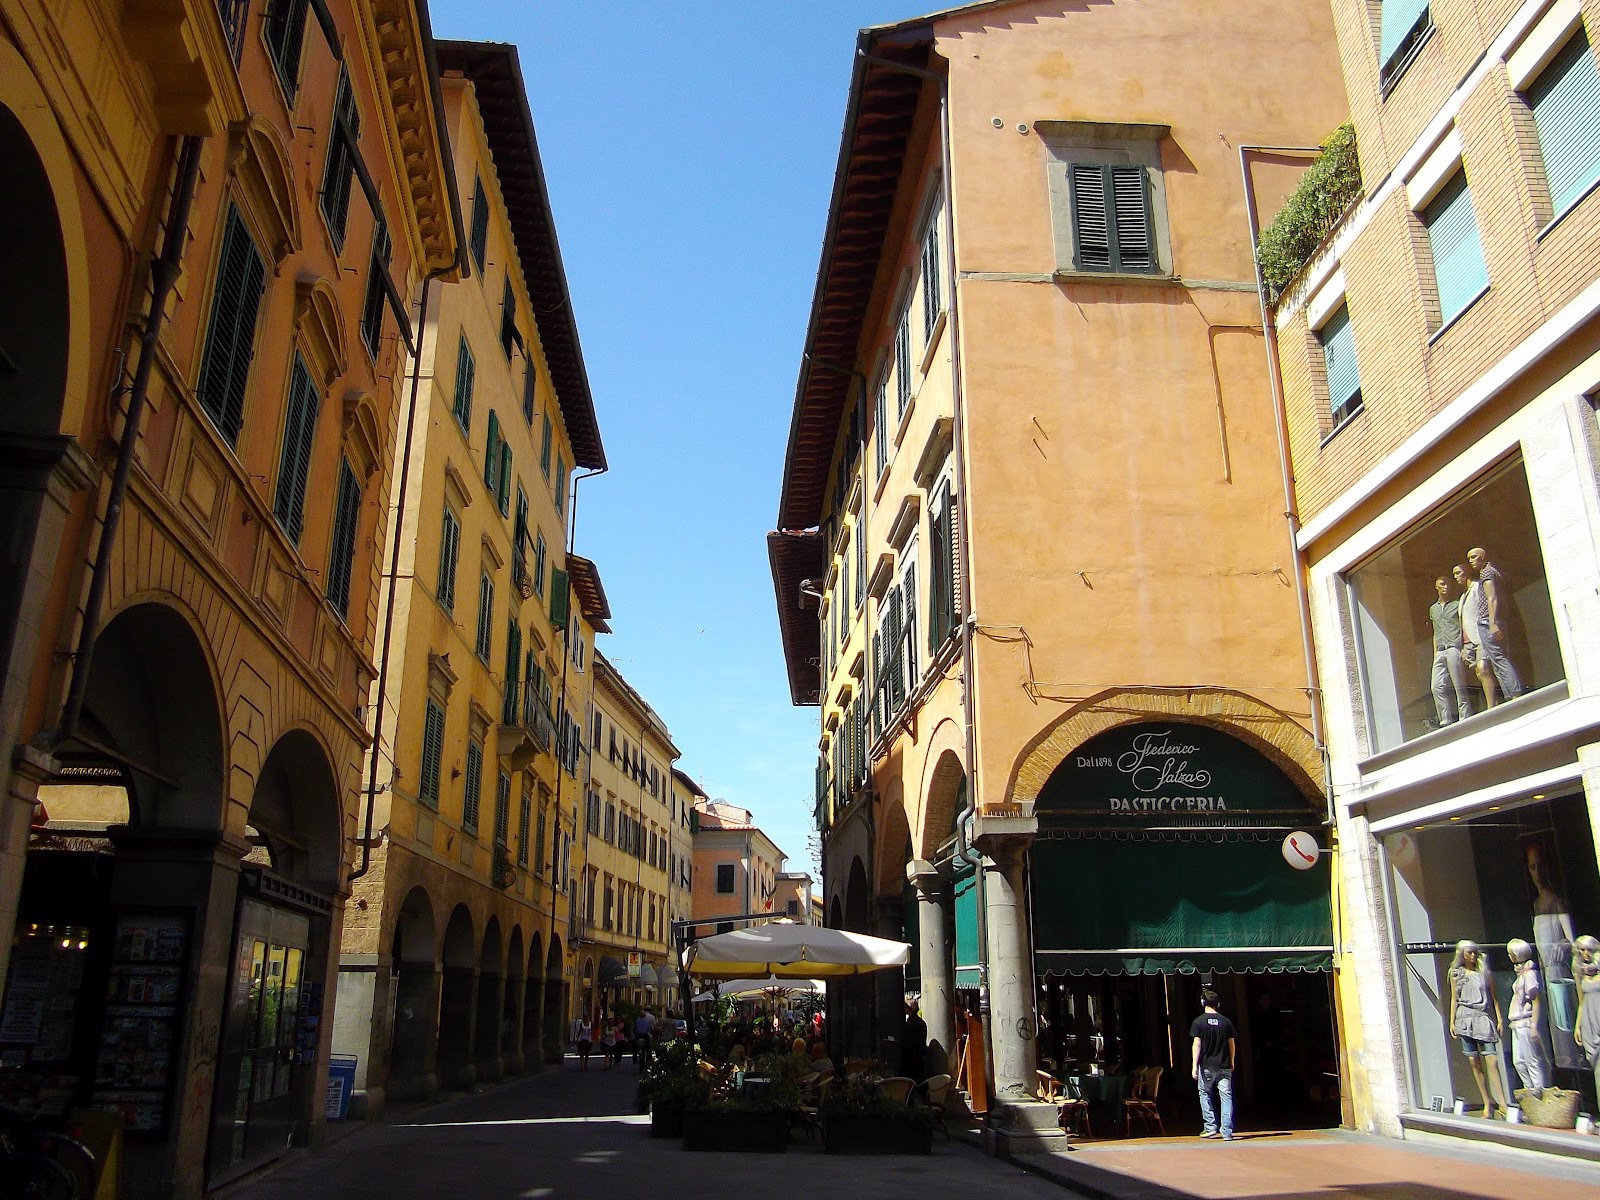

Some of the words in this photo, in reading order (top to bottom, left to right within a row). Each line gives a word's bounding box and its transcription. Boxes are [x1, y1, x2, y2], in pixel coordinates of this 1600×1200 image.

[1077, 756, 1095, 768] Dal
[1095, 756, 1113, 767] 1898
[1117, 730, 1200, 773] Federico
[1132, 757, 1211, 792] Salza
[1109, 797, 1226, 815] PASTICCERIA
